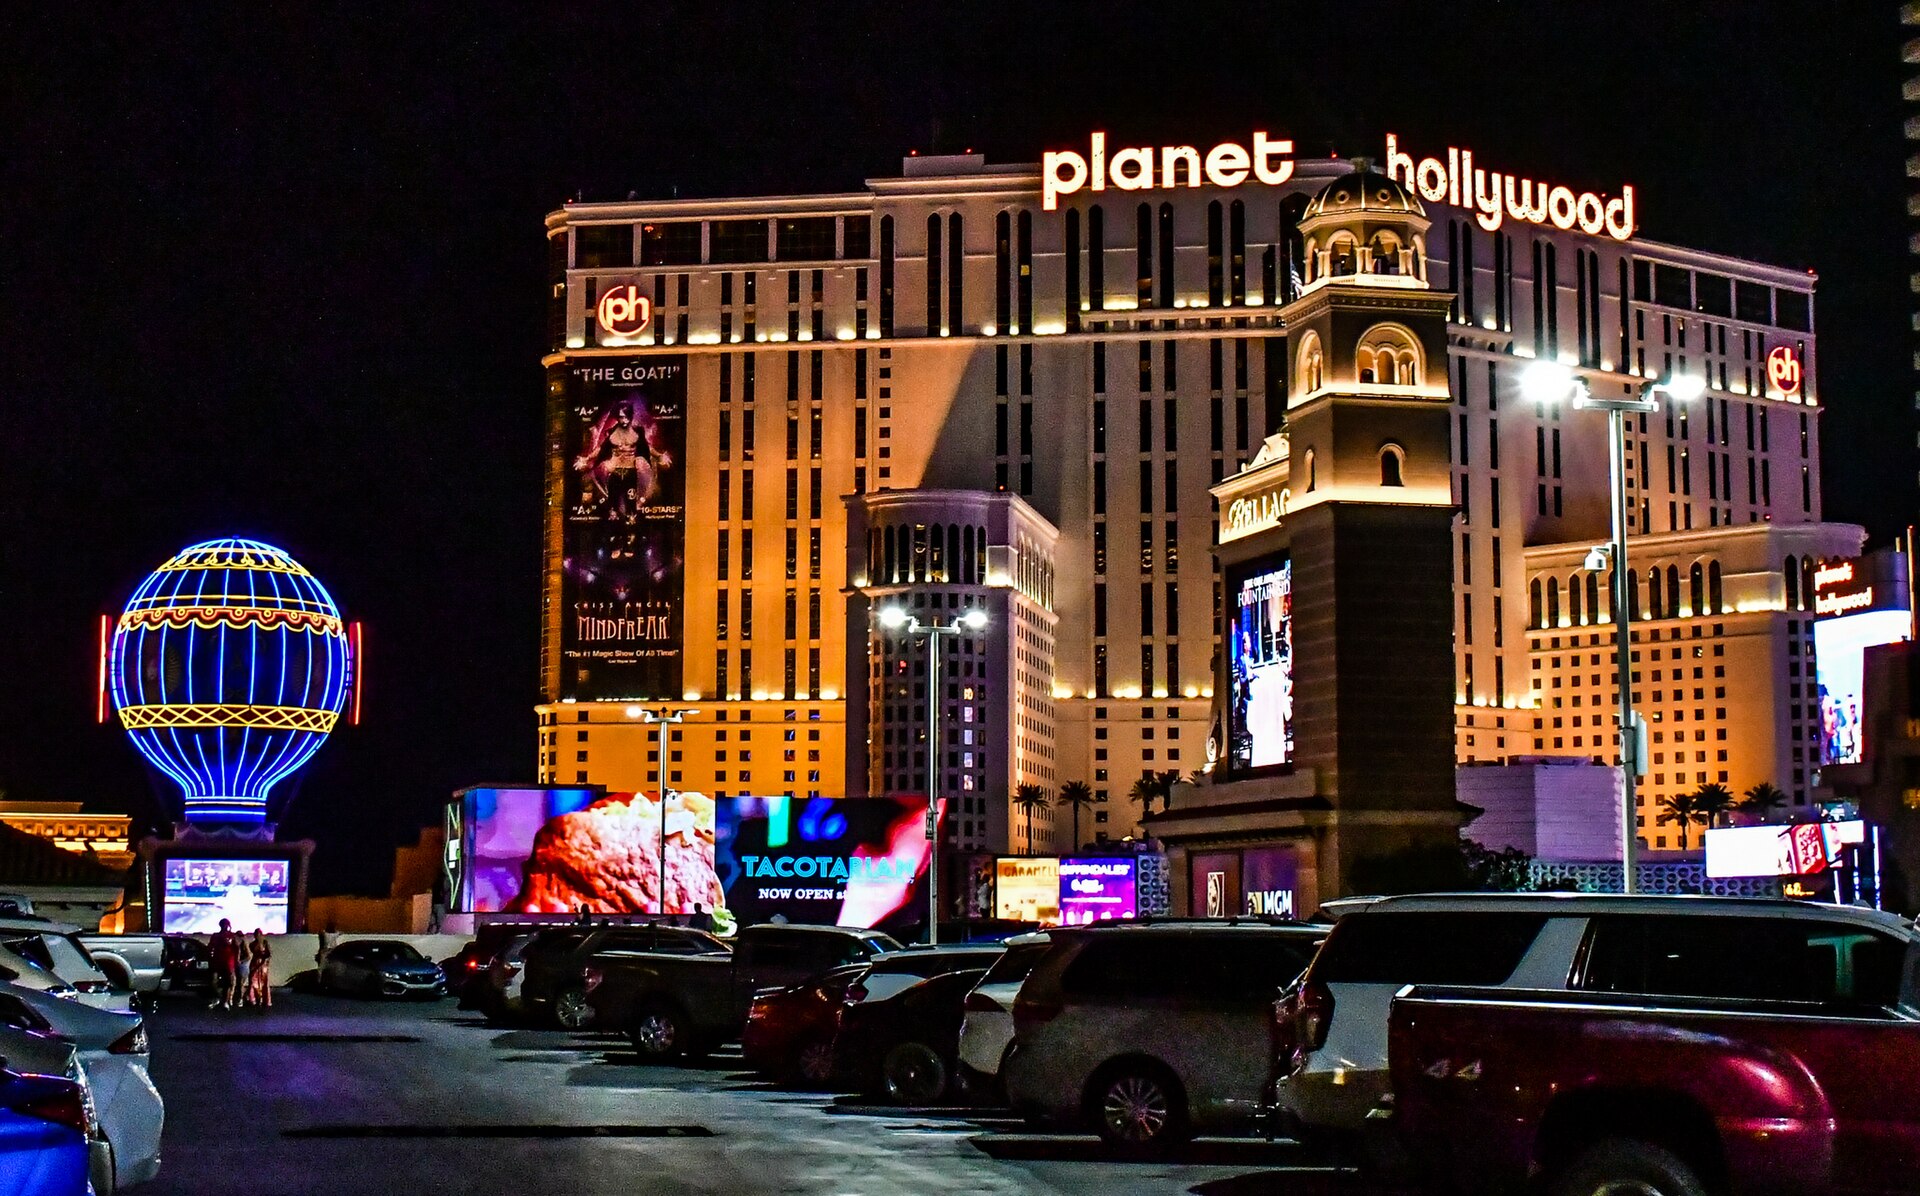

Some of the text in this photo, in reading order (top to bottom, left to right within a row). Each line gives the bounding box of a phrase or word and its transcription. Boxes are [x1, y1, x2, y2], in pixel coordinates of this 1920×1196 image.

[1042, 131, 1634, 241] planet hollywood
[605, 286, 650, 329] ph
[578, 615, 668, 641] MINDFREAK
[741, 855, 916, 879] TACOTARIAN
[758, 888, 793, 899] NOW
[794, 888, 834, 900] OPEN
[1263, 889, 1293, 915] MGM
